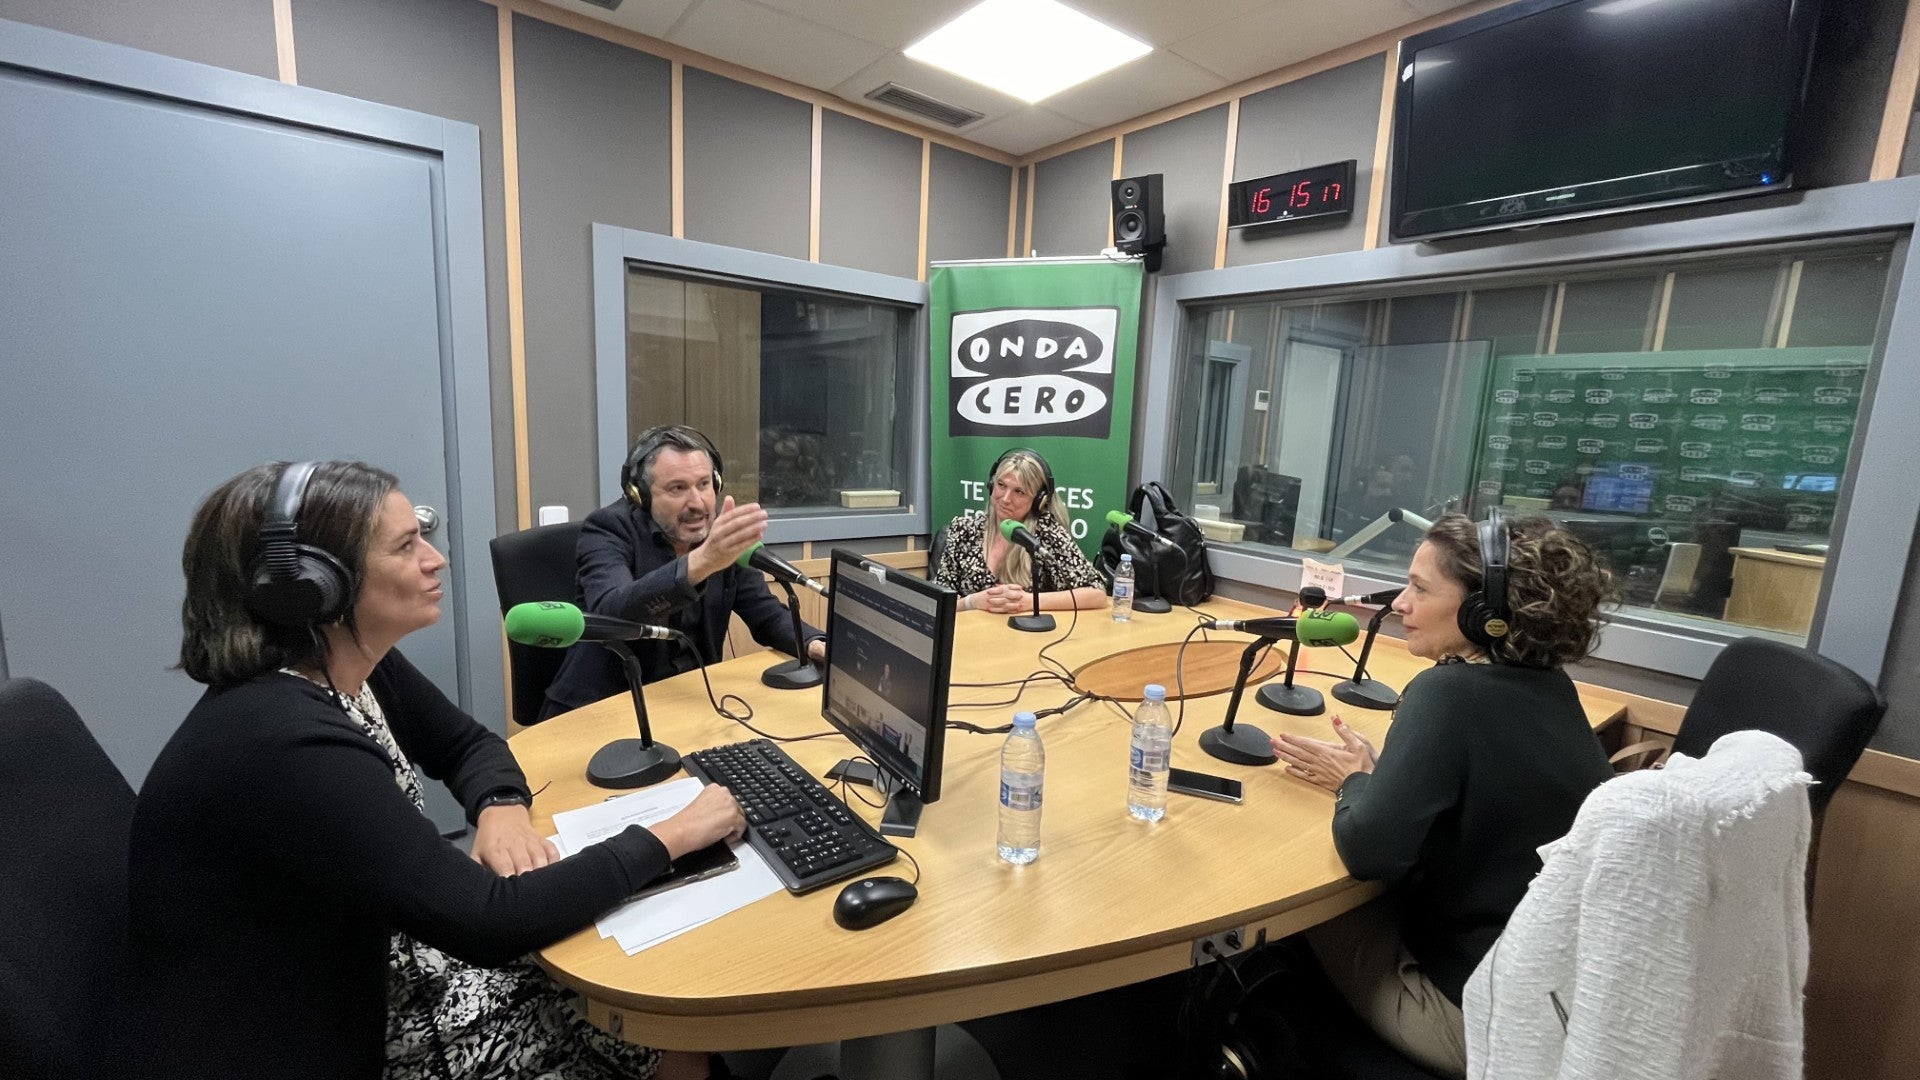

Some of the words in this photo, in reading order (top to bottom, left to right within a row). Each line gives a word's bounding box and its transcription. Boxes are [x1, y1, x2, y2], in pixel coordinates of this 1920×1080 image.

[1252, 188, 1271, 213] 16
[1290, 181, 1311, 208] 15
[1323, 183, 1341, 202] 17
[970, 335, 1088, 363] ONDA
[975, 386, 1086, 414] CERO
